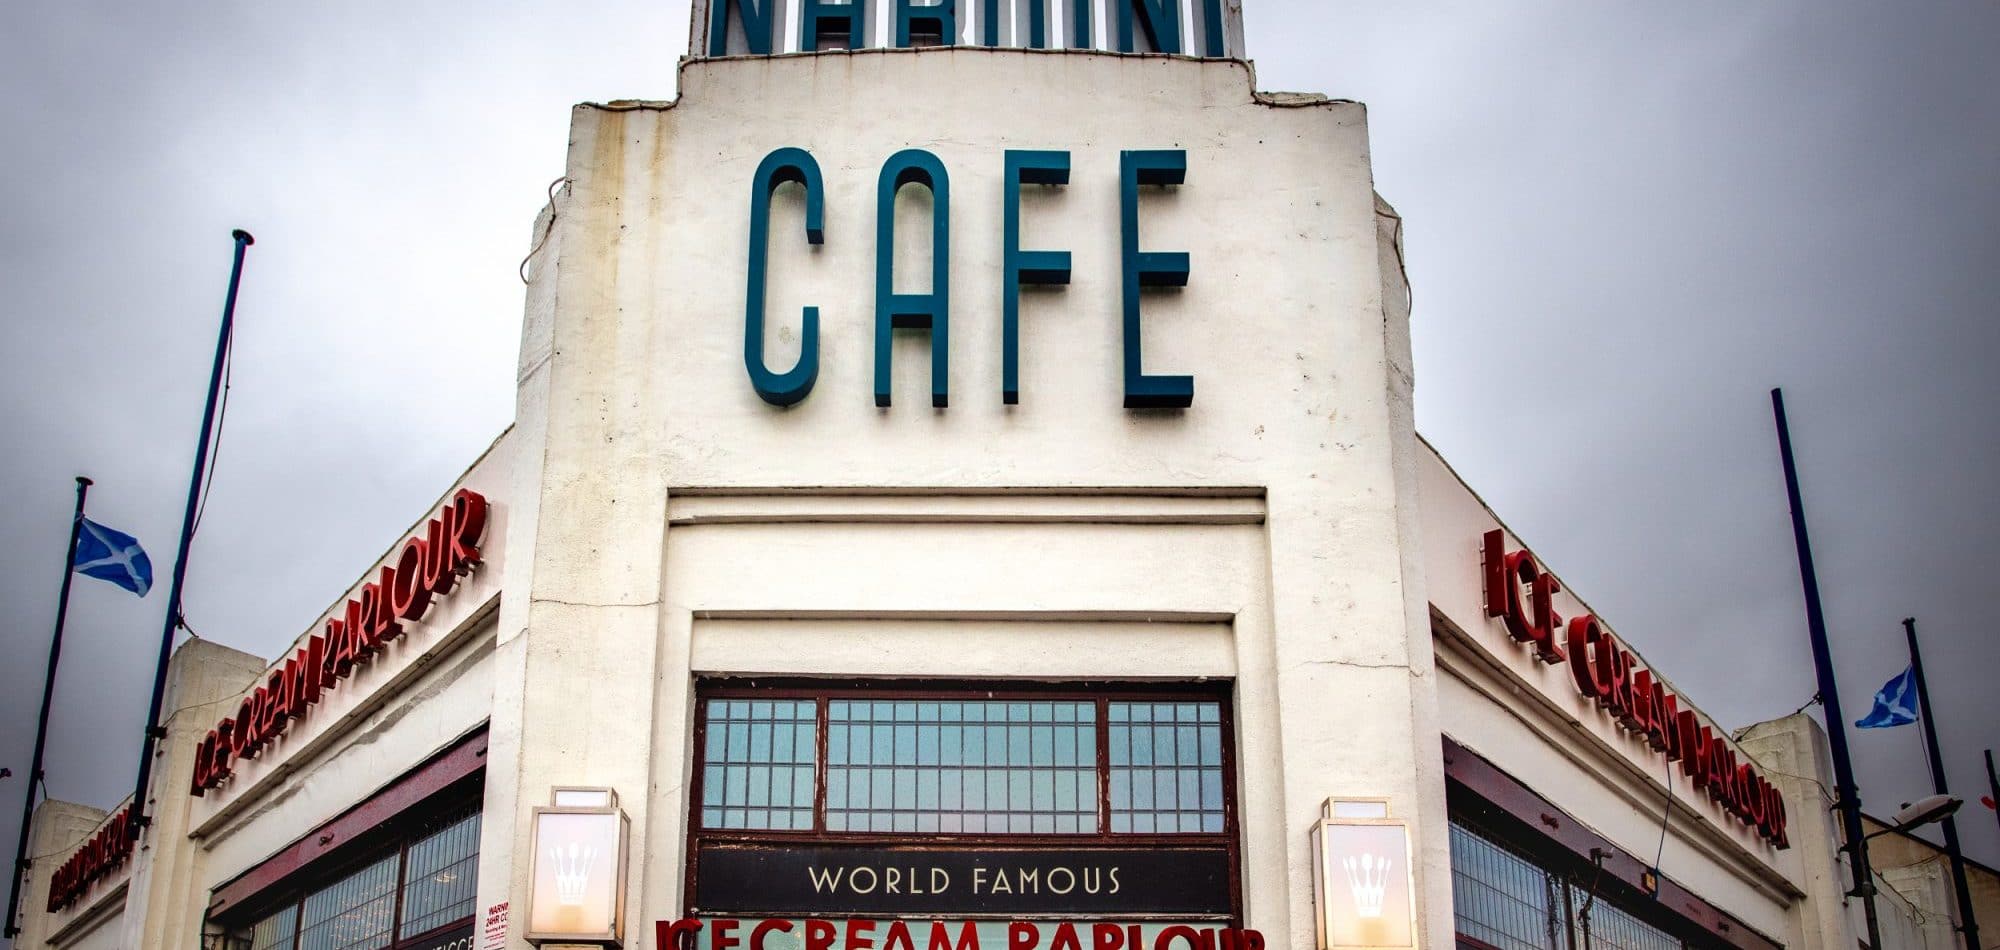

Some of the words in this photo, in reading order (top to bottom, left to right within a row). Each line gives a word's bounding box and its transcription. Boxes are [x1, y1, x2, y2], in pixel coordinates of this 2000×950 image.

[744, 147, 1195, 409] CAFE
[191, 717, 235, 797] ICE
[231, 635, 326, 761] CREAM
[319, 488, 487, 690] PARLOUR
[1484, 528, 1566, 666] ICE
[1566, 613, 1683, 762] CREAM
[1677, 710, 1791, 850] PARLOUR
[808, 867, 951, 895] WORLD
[972, 866, 1122, 895] FAMOUS
